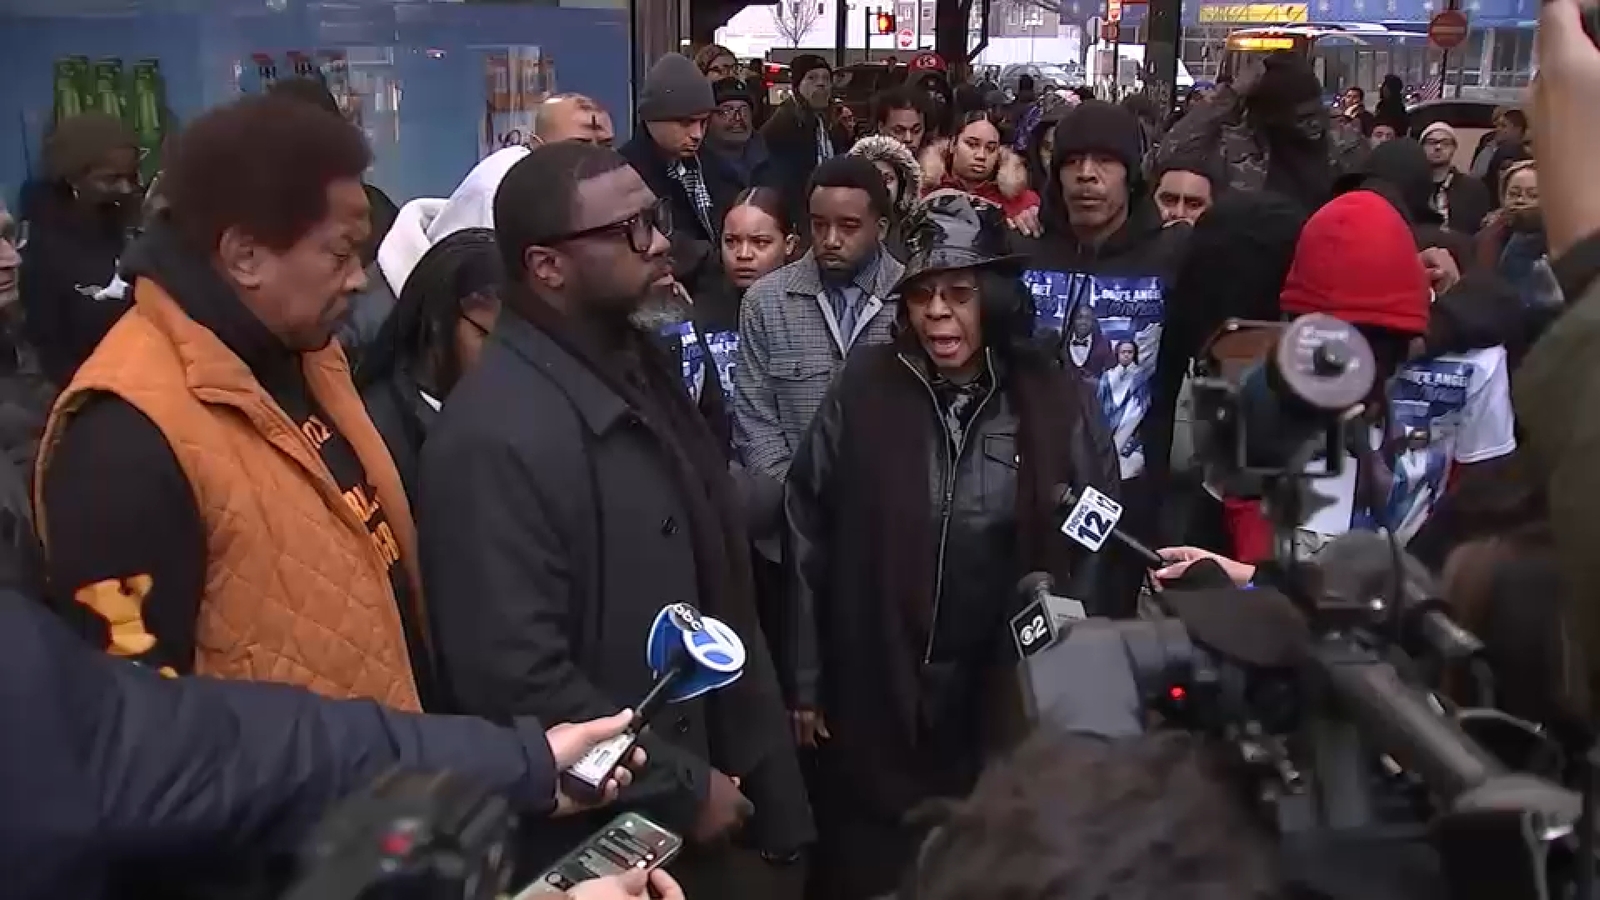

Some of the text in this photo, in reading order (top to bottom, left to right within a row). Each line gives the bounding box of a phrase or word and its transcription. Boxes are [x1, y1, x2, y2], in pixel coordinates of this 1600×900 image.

[1067, 504, 1089, 532] news
[1078, 511, 1112, 542] 12
[674, 604, 702, 630] abc
[1032, 615, 1047, 639] 2
